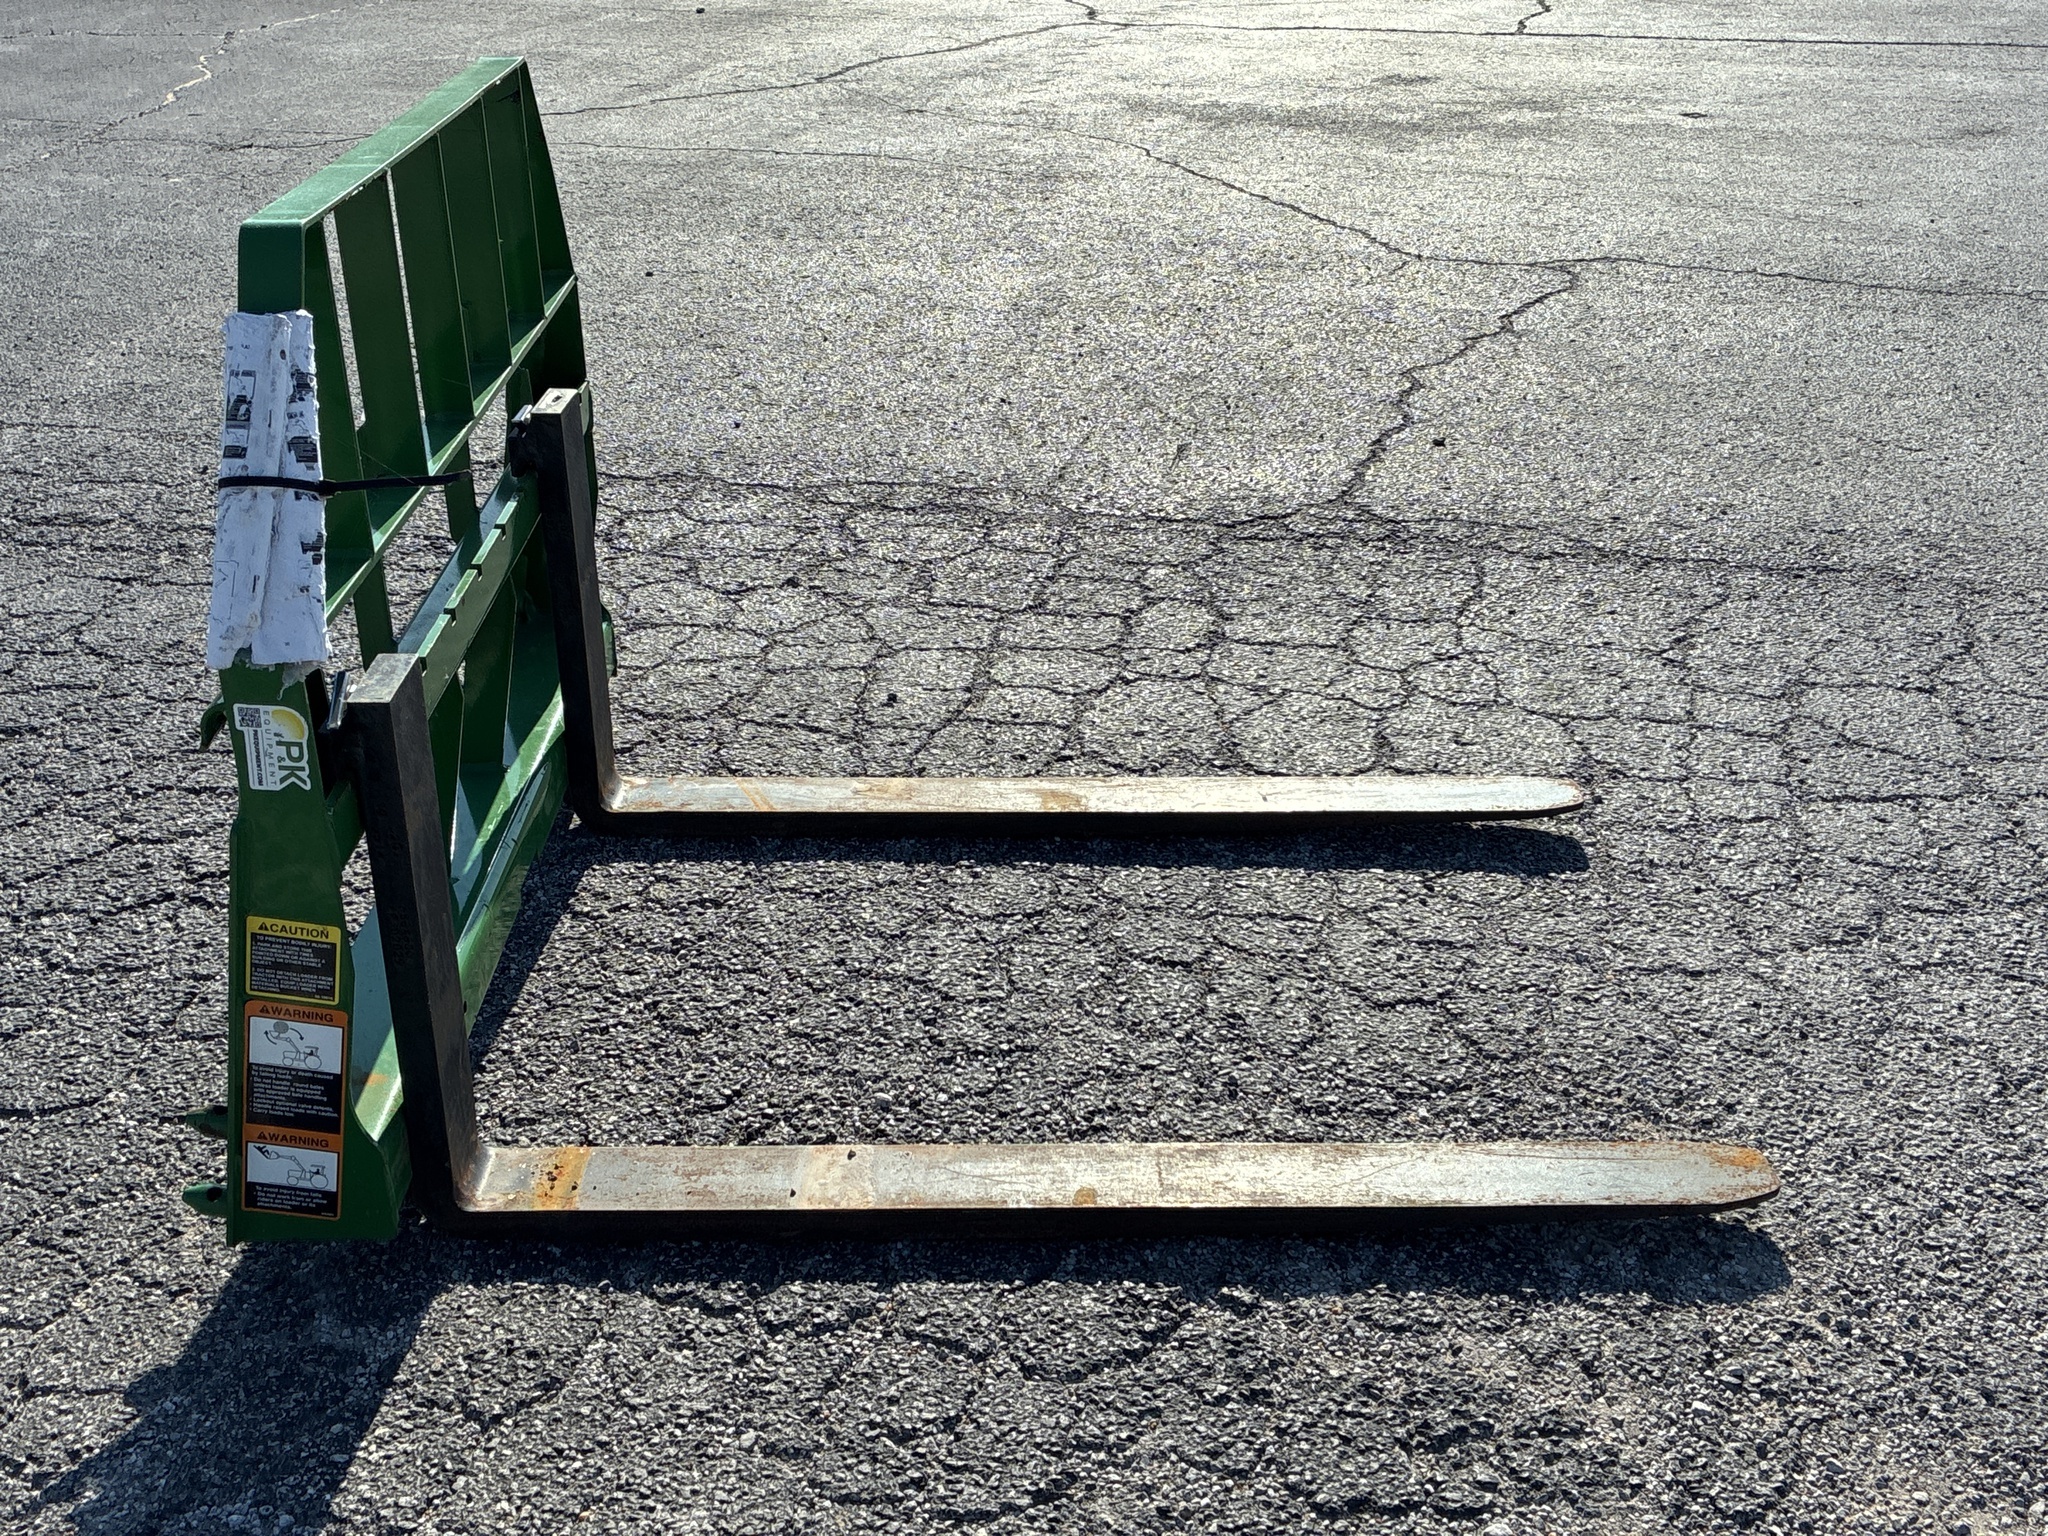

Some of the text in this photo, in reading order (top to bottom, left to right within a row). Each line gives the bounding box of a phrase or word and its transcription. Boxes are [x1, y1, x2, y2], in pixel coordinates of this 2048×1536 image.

[263, 711, 276, 786] EQUIPMENT
[270, 923, 329, 939] CAUTION
[271, 1006, 334, 1022] WARNING
[268, 1132, 329, 1148] WARNING
